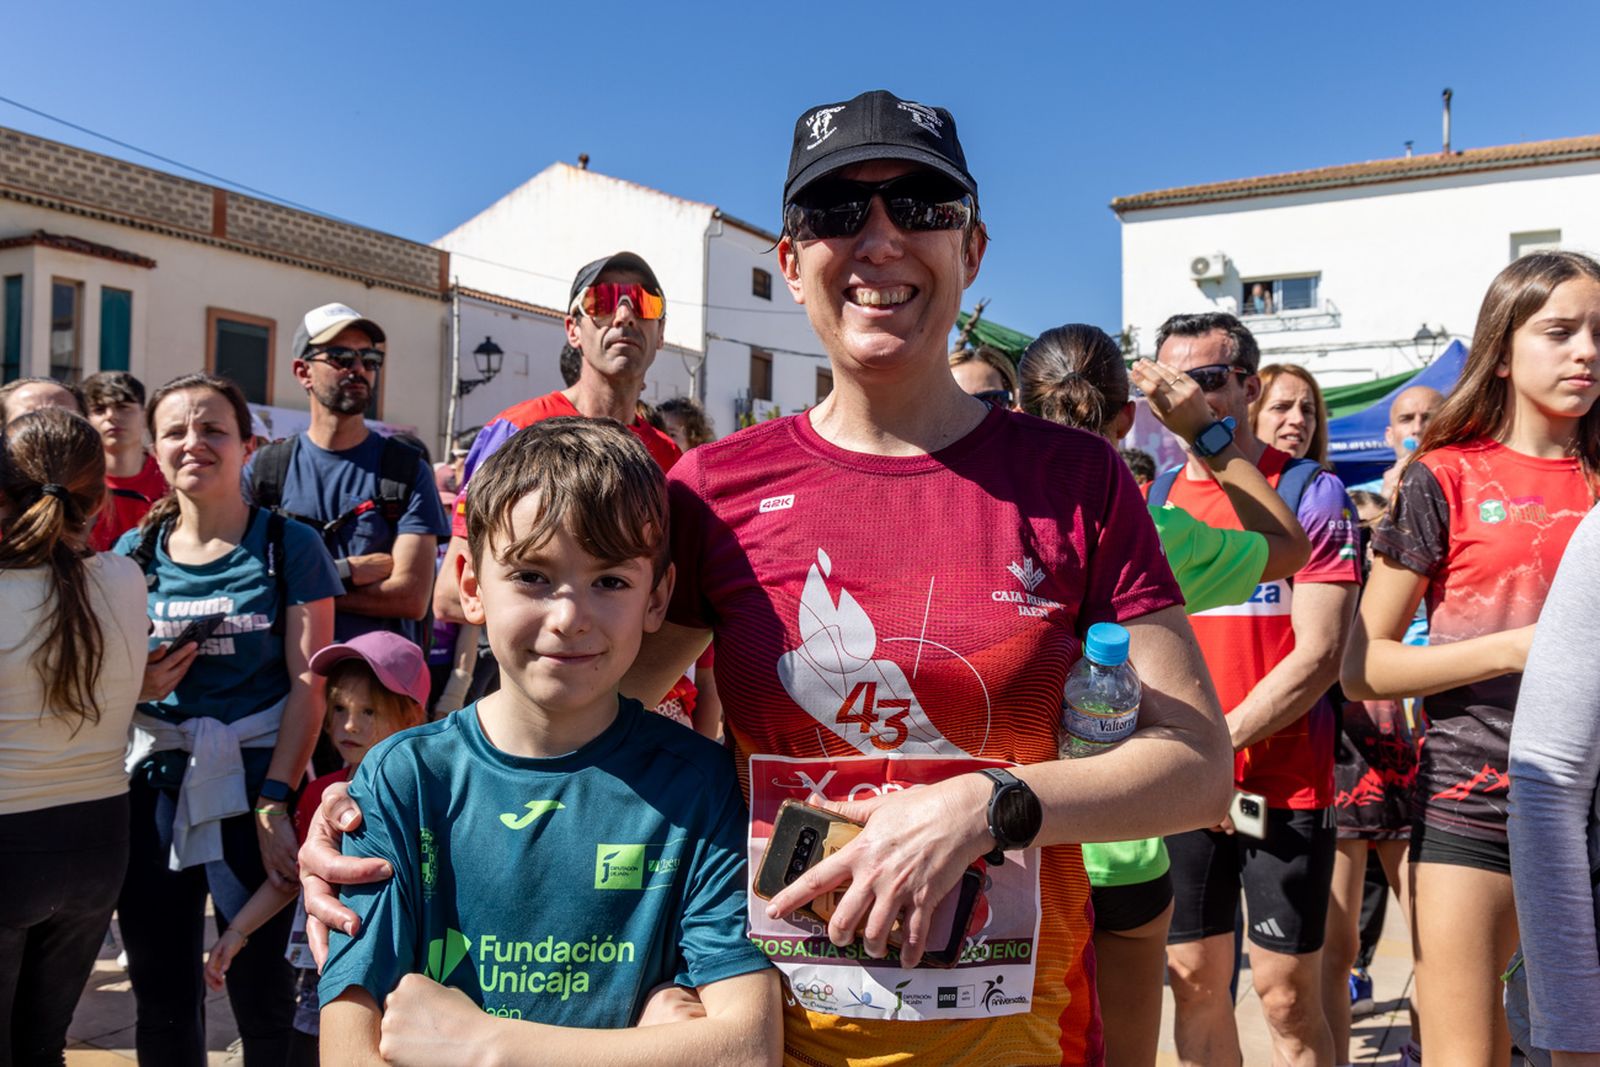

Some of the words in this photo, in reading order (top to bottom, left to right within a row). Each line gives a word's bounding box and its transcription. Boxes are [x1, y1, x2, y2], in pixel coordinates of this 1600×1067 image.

[762, 498, 791, 508] 42K
[835, 682, 911, 750] 43
[479, 934, 635, 963] Fundación
[479, 964, 590, 1001] Unicaja
[481, 1004, 522, 1020] aén
